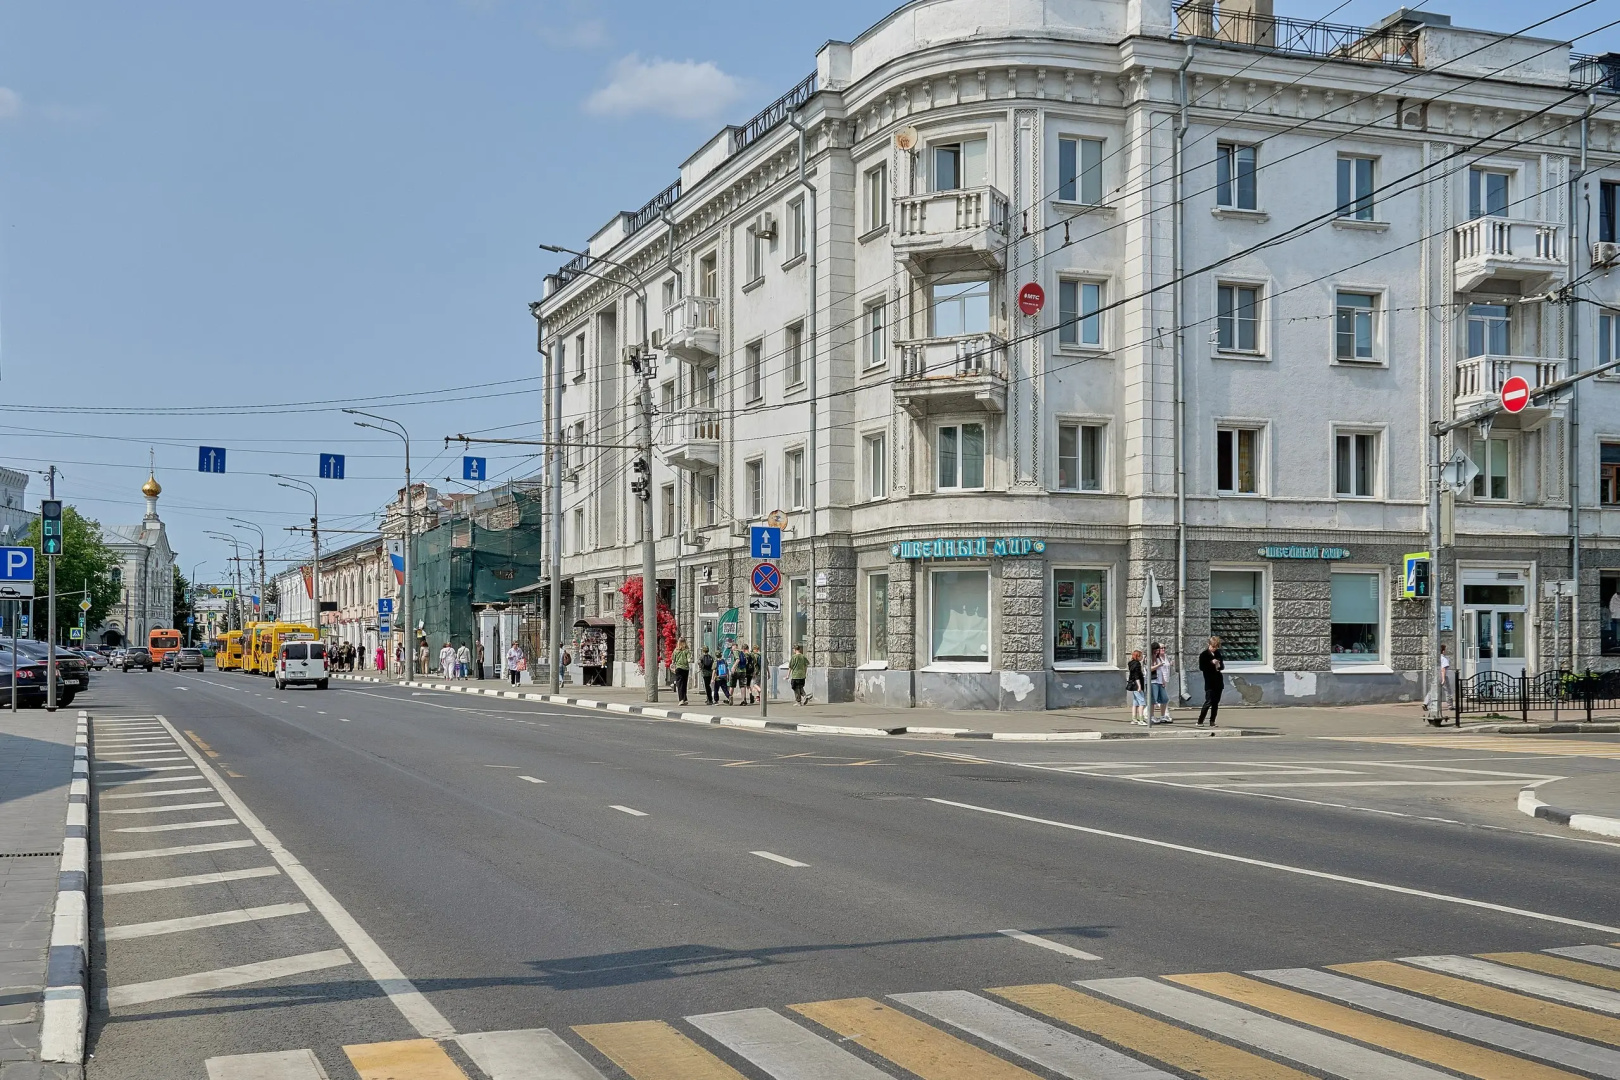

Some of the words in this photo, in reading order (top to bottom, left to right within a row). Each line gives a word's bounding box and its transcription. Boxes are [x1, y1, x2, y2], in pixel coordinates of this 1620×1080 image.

[44, 519, 61, 536] 61
[900, 537, 987, 559] ШВЕЙНЫЙ
[993, 537, 1033, 556] МИР
[1265, 545, 1319, 559] ШВЕЙНЫЙ
[1321, 547, 1343, 559] МИР
[7, 551, 28, 577] P
